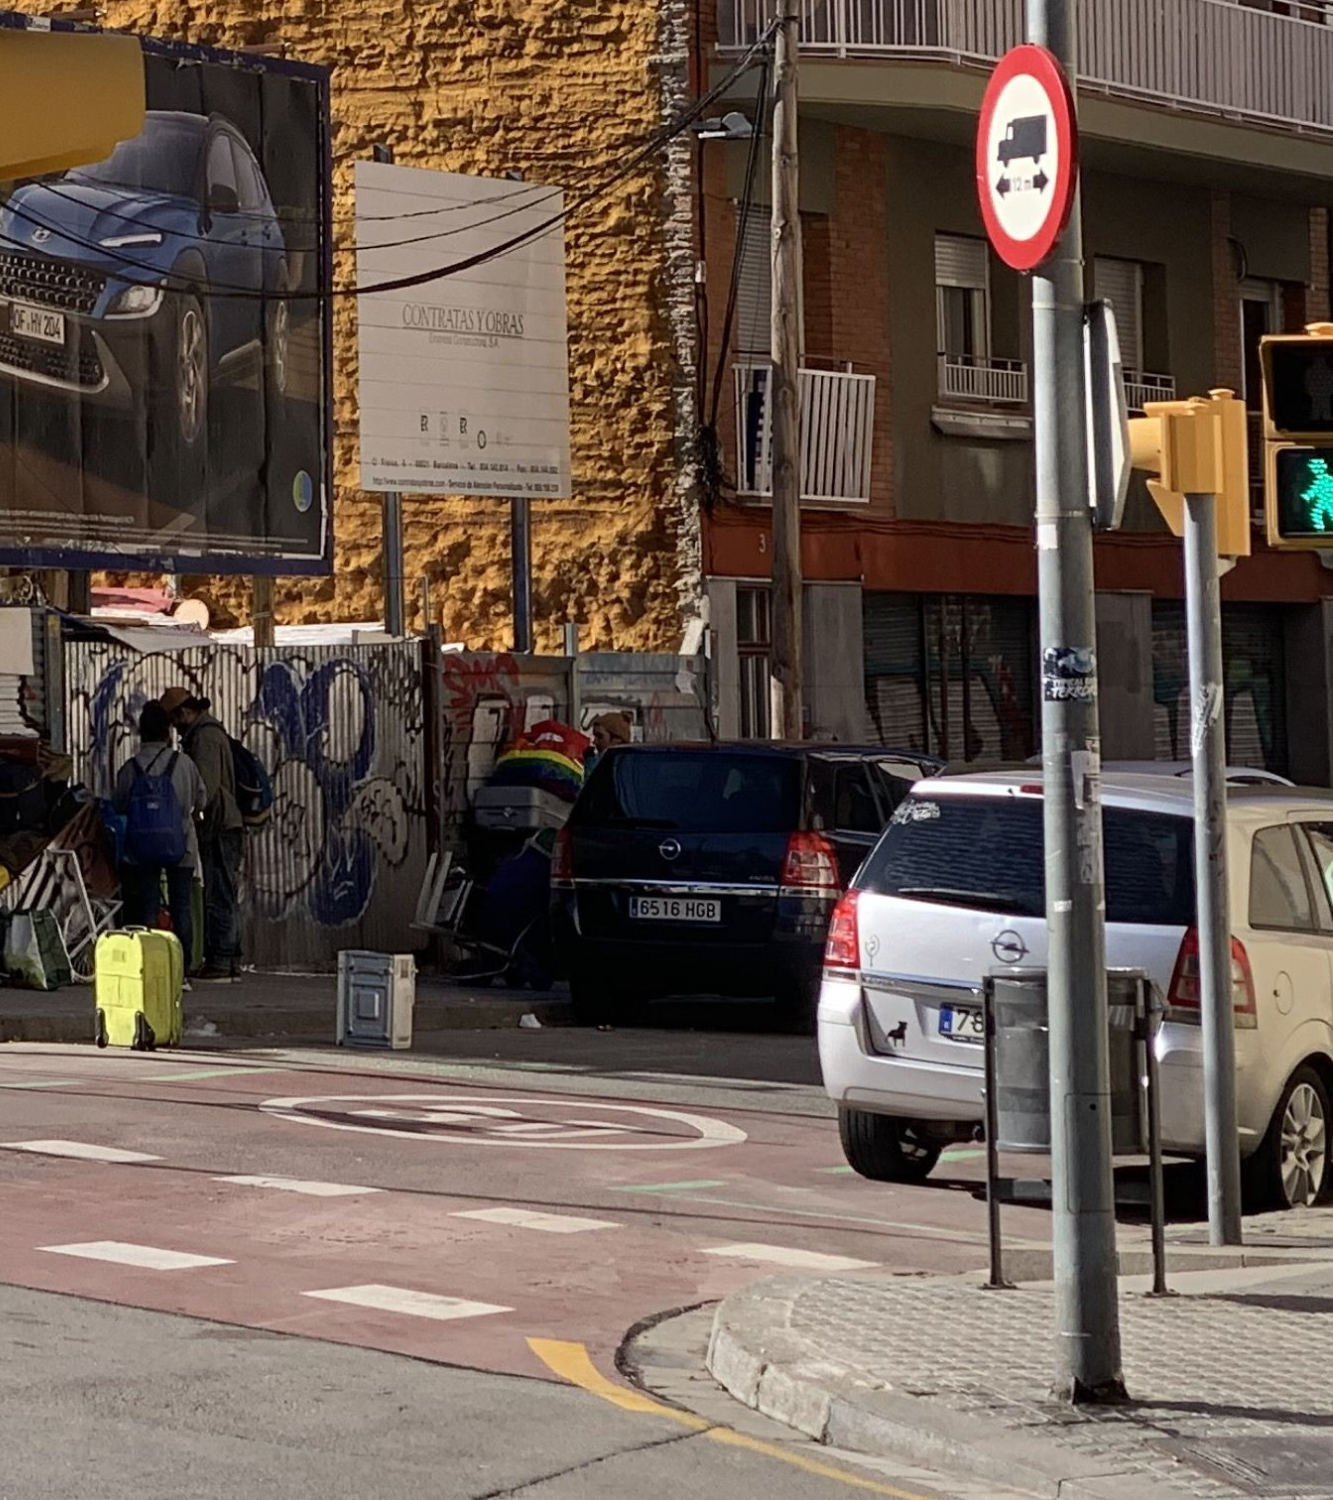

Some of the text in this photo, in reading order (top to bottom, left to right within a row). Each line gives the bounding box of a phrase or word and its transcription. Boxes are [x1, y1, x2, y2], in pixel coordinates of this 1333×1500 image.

[402, 304, 524, 336] CONTRATAS Y OBRAS
[640, 901, 716, 919] 6516 HGB
[957, 1009, 984, 1034] 78
